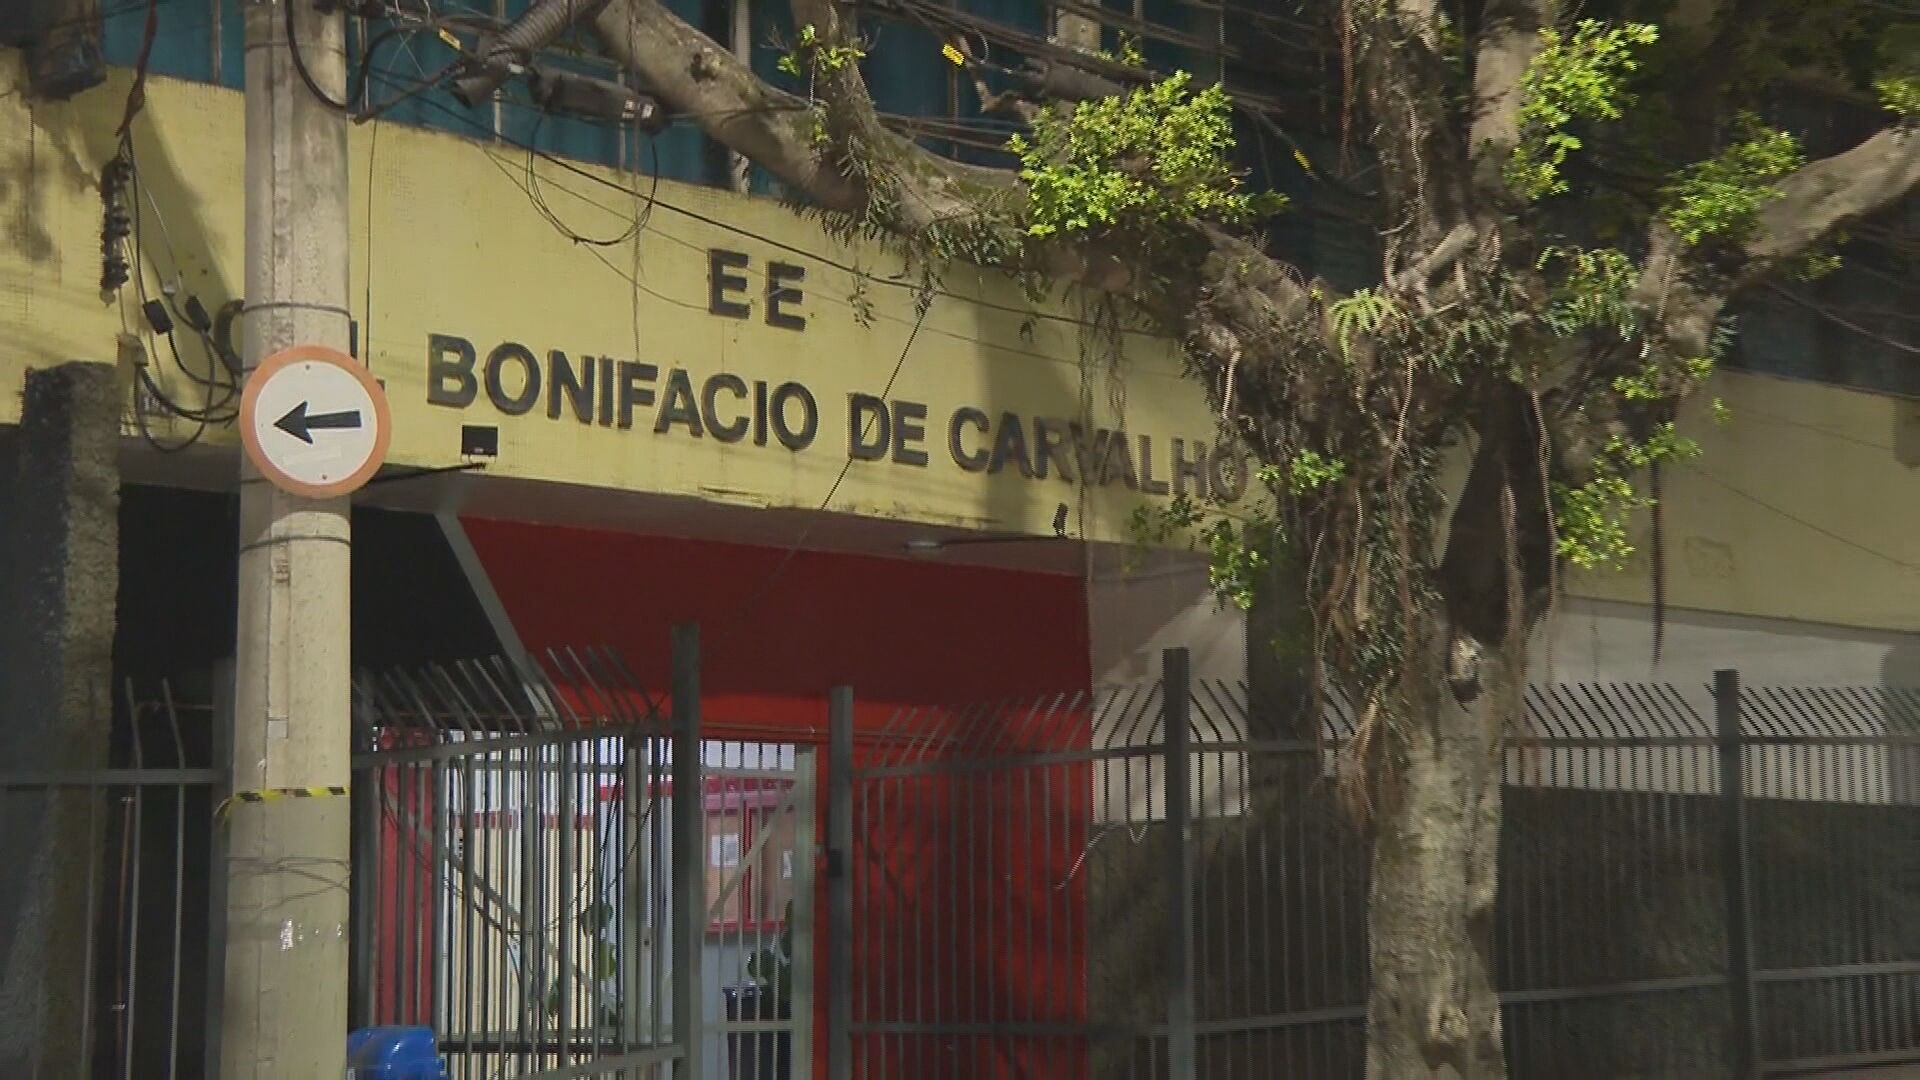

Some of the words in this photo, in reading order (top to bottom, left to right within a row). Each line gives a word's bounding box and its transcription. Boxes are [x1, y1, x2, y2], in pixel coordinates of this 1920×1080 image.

[708, 249, 806, 332] EE
[428, 333, 818, 452] BONIFACIO
[847, 392, 929, 467] DE
[947, 406, 1248, 502] CARVALHO
